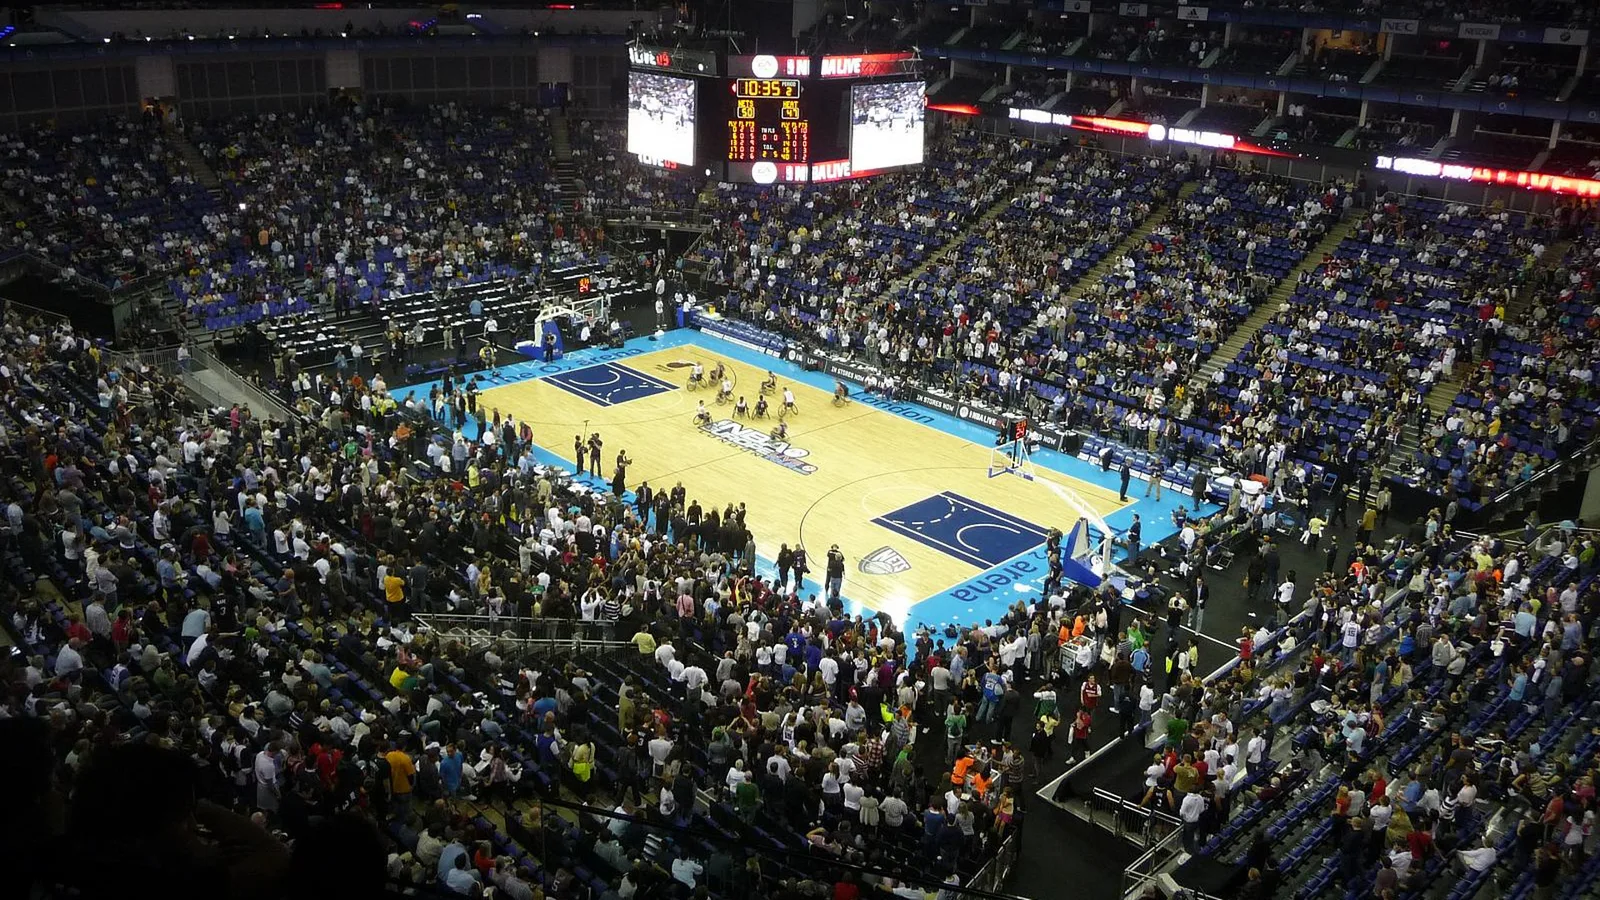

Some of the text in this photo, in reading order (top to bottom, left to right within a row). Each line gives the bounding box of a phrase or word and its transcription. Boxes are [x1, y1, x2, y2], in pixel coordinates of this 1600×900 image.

[1384, 22, 1413, 31] NEC
[840, 58, 862, 74] LIVE
[744, 80, 780, 96] 10:35
[786, 87, 792, 96] 2
[742, 108, 753, 117] 50
[786, 109, 798, 118] 47
[826, 162, 850, 179] LIVE
[580, 284, 589, 292] 24
[576, 348, 645, 366] arena
[838, 368, 854, 380] STORES
[850, 391, 935, 424] London
[923, 396, 942, 408] STORES
[943, 403, 955, 412] NOW
[984, 414, 997, 426] LIVE
[712, 419, 791, 453] NBA
[1016, 428, 1024, 438] 24
[1043, 435, 1056, 445] NOW
[876, 546, 910, 572] NETS
[949, 560, 1038, 602] arena
